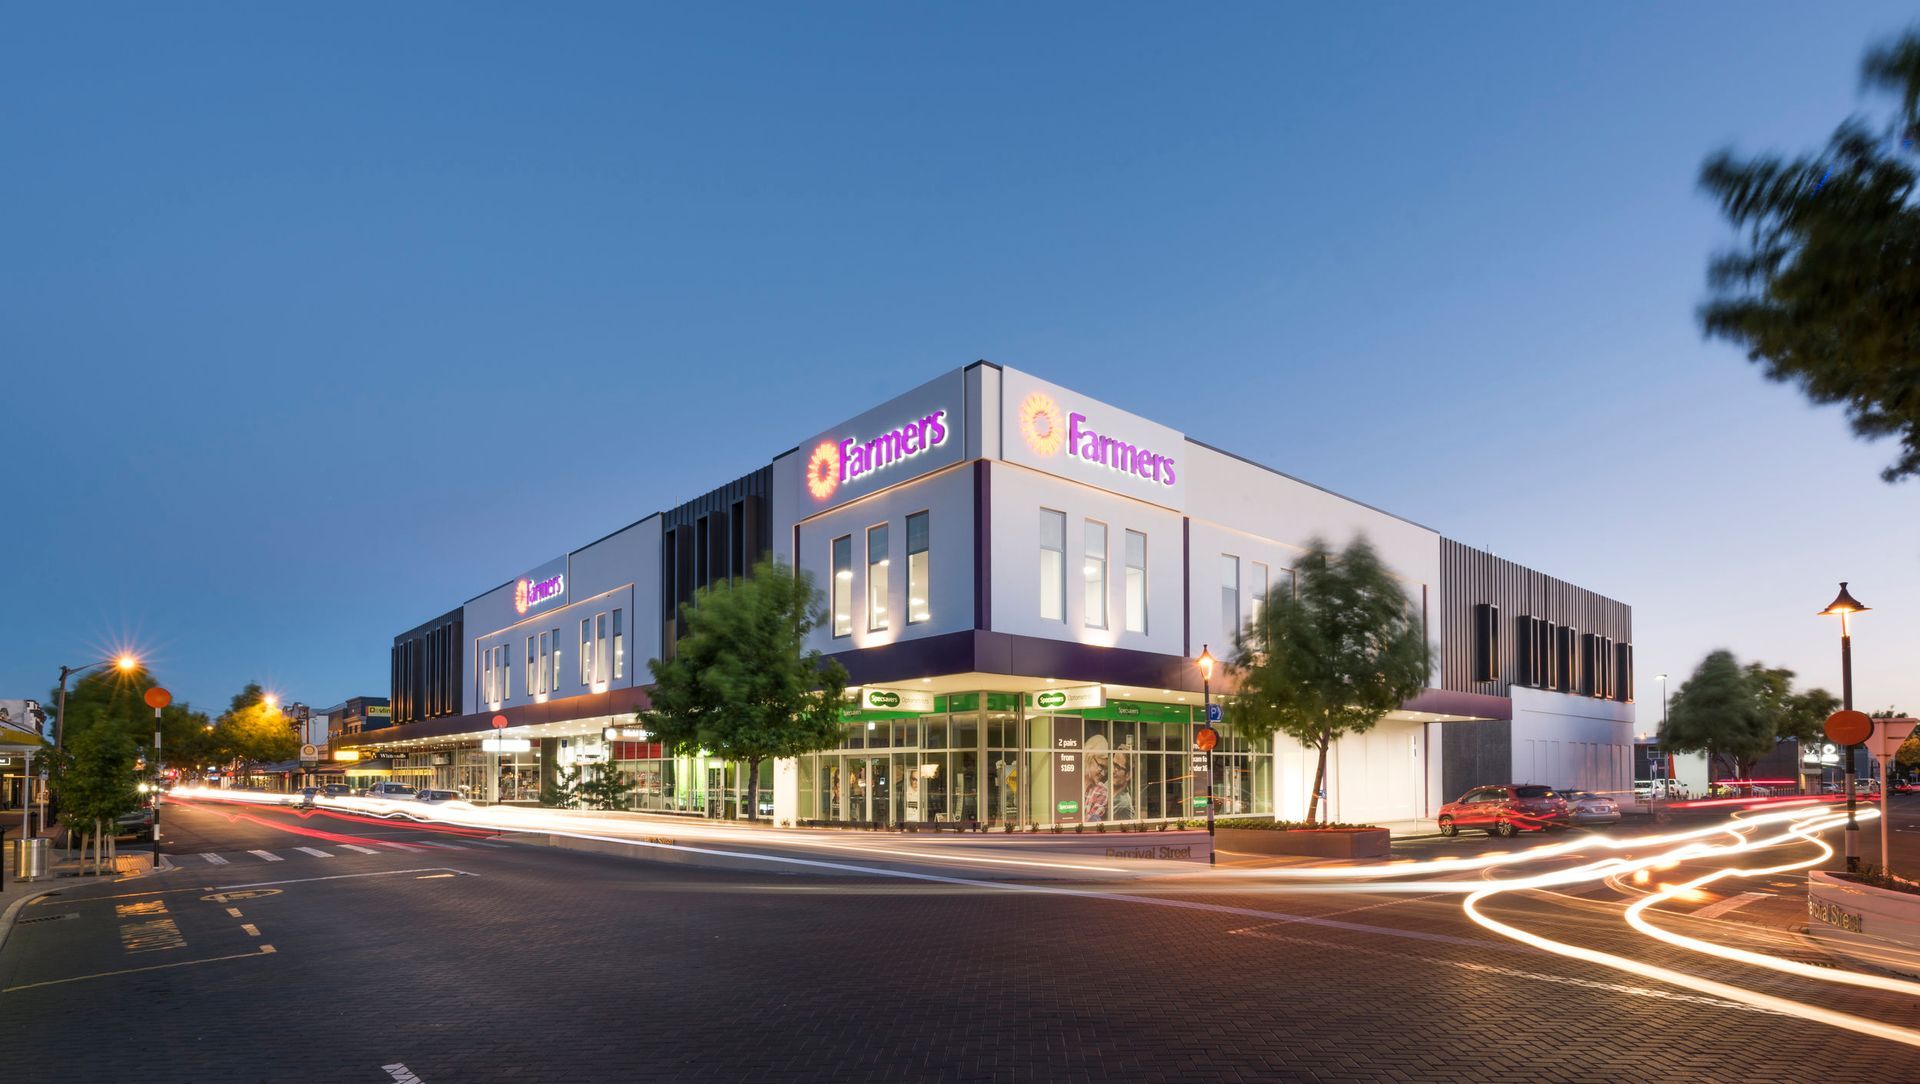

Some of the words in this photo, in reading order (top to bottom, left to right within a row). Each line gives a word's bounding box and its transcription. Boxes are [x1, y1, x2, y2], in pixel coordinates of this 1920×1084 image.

[839, 410, 946, 482] Farmers
[1068, 412, 1176, 486] Farmers
[526, 575, 563, 605] Farmers
[871, 694, 898, 703] Specsavers
[1039, 696, 1064, 704] Specsavers
[1210, 708, 1217, 718] P
[1058, 738, 1063, 747] 2
[1063, 738, 1077, 749] pairs
[1061, 753, 1075, 762] from
[1061, 764, 1075, 773] $169
[1106, 847, 1156, 860] Percival
[1159, 846, 1192, 859] Street
